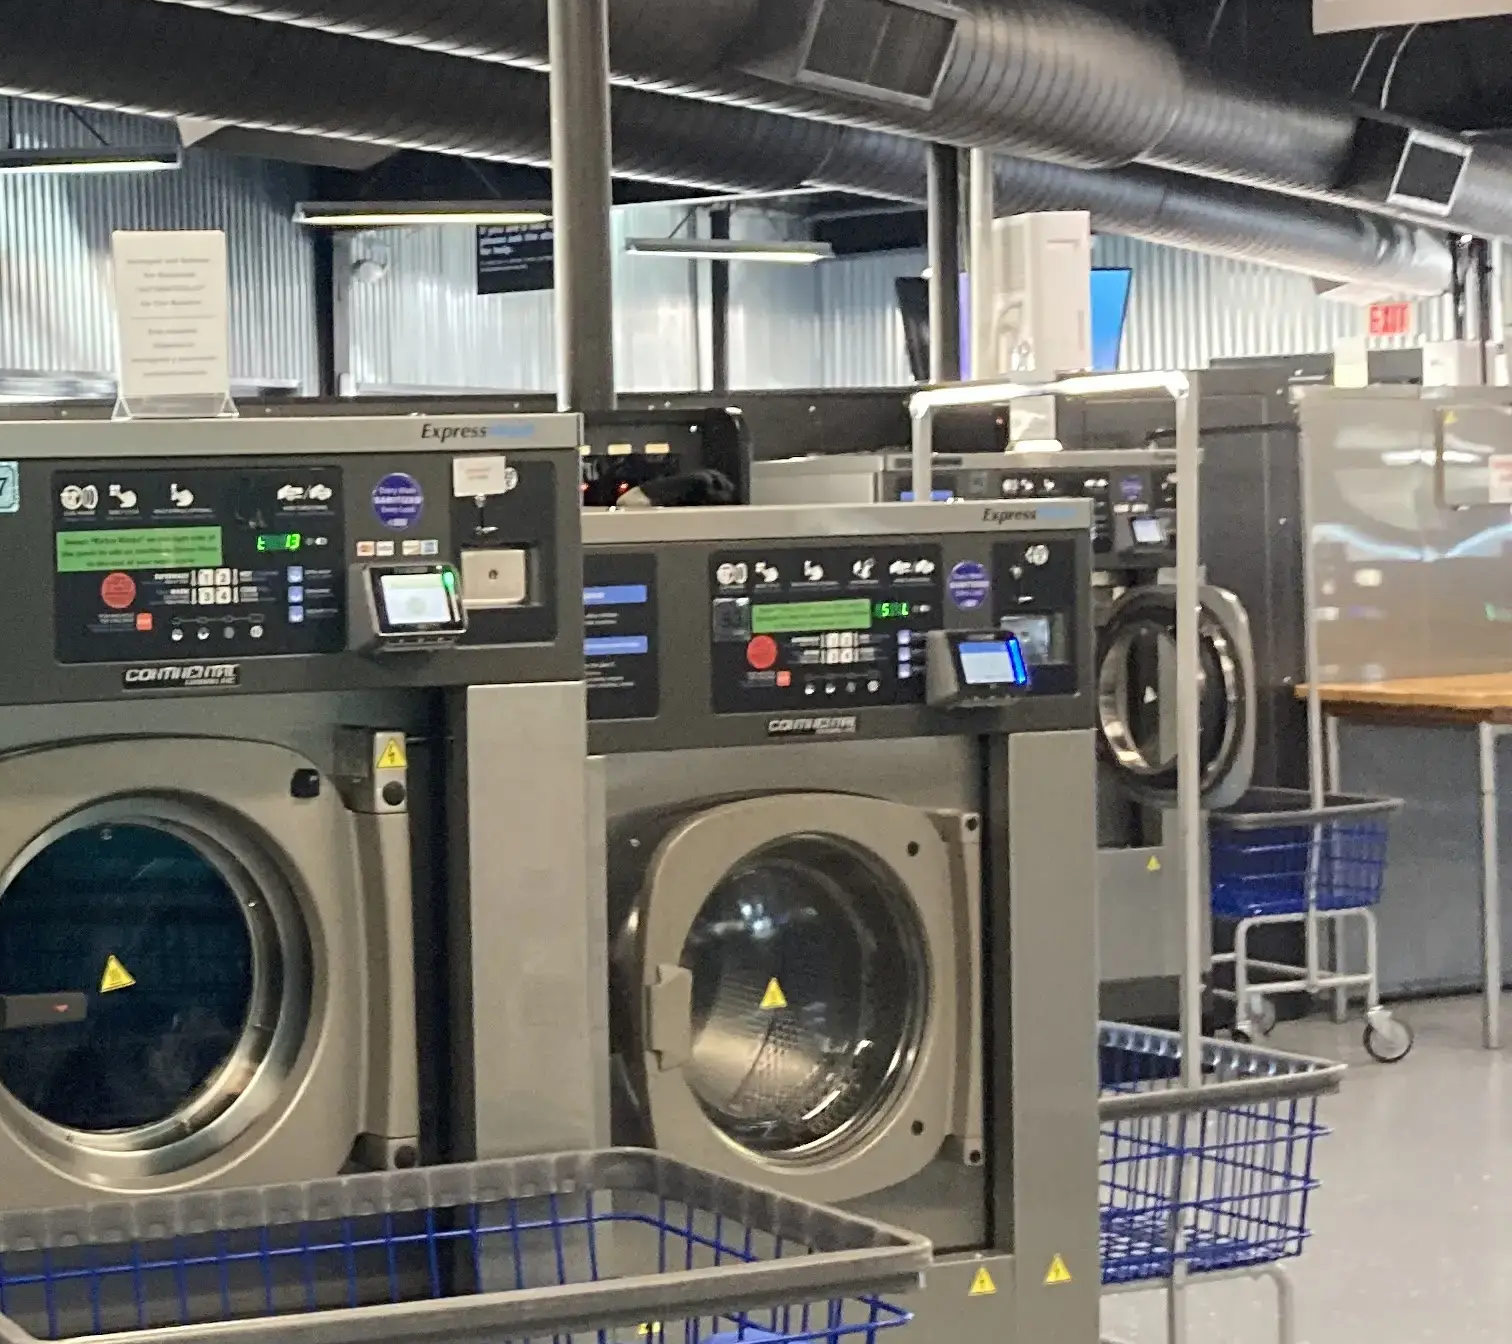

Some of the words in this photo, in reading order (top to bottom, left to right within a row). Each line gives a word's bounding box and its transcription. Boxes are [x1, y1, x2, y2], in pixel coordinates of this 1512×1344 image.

[1369, 305, 1409, 333] EXIT
[422, 423, 534, 443] Express
[982, 507, 1077, 525] Express
